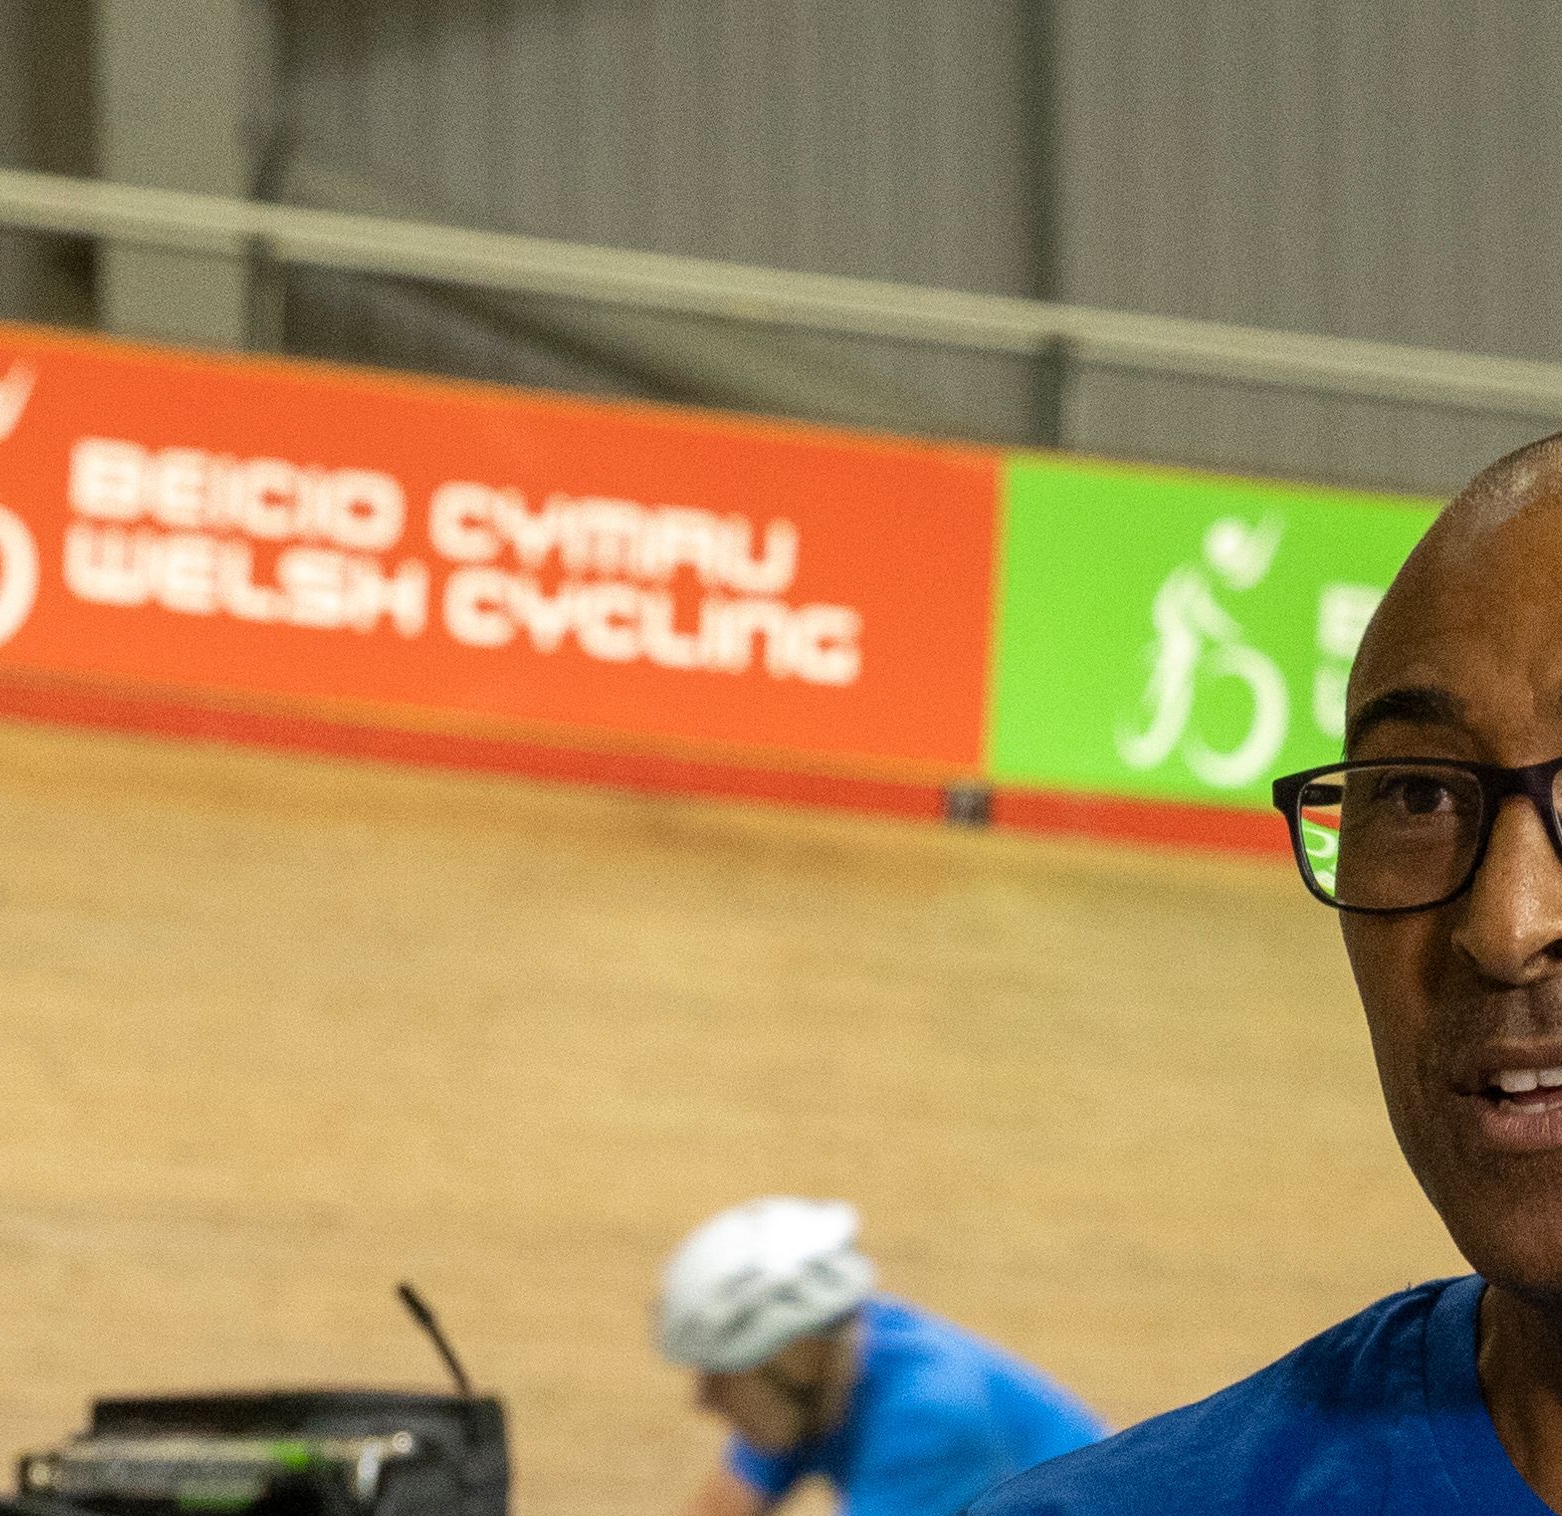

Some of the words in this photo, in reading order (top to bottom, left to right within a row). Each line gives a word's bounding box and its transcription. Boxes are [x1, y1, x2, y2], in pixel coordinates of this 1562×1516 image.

[67, 436, 407, 554] BEICIO
[427, 481, 801, 597] CYMRU
[61, 523, 429, 640] WELSH
[442, 566, 864, 688] CYCLING
